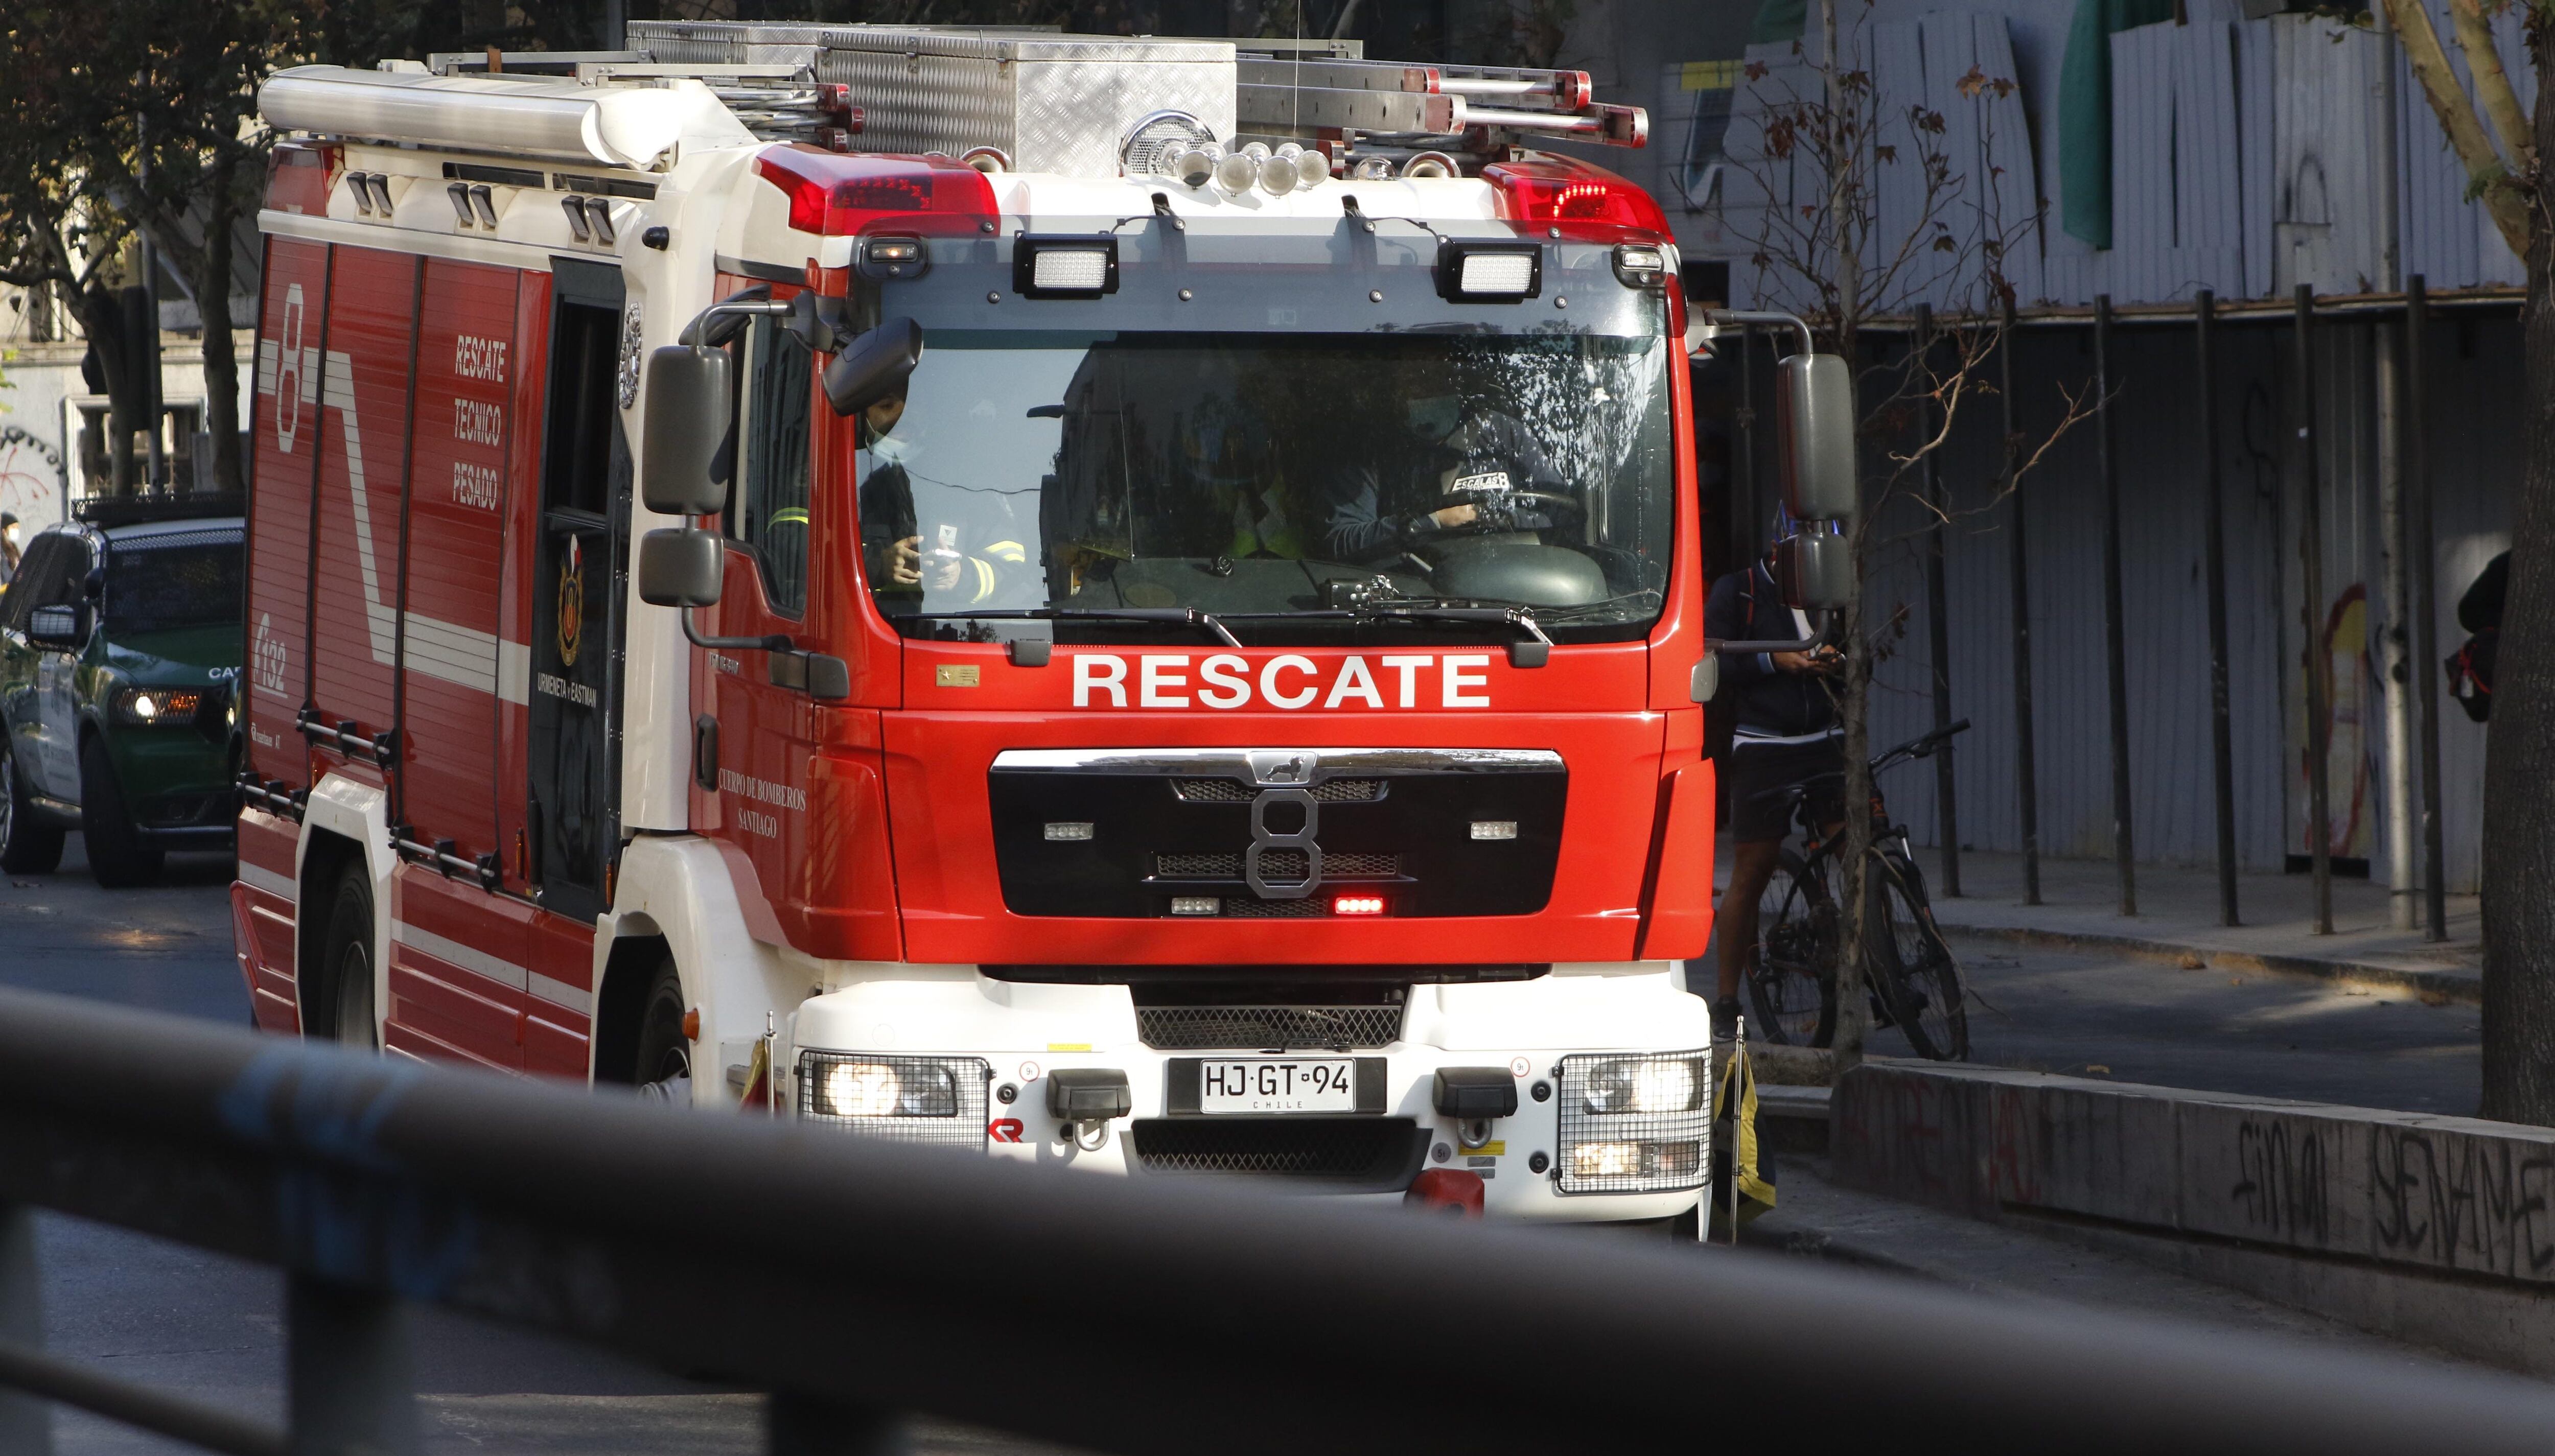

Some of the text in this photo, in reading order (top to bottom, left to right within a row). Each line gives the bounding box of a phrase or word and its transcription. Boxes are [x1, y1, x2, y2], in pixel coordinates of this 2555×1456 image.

[276, 283, 304, 453] 8
[455, 335, 506, 383] RESCATE
[454, 398, 501, 447] TECNICO
[453, 462, 497, 511] PESADO
[1452, 472, 1510, 492] ESCALAS 8
[262, 639, 287, 691] 132
[1073, 654, 1491, 709] RESCATE
[538, 672, 567, 699] URMENETA
[571, 682, 597, 708] EASTMAN
[718, 767, 806, 812] CUERPO DE BOMBEROS
[738, 808, 777, 839] SANTIAGO
[1245, 788, 1321, 899] 8
[2373, 1122, 2555, 1278] SENAME
